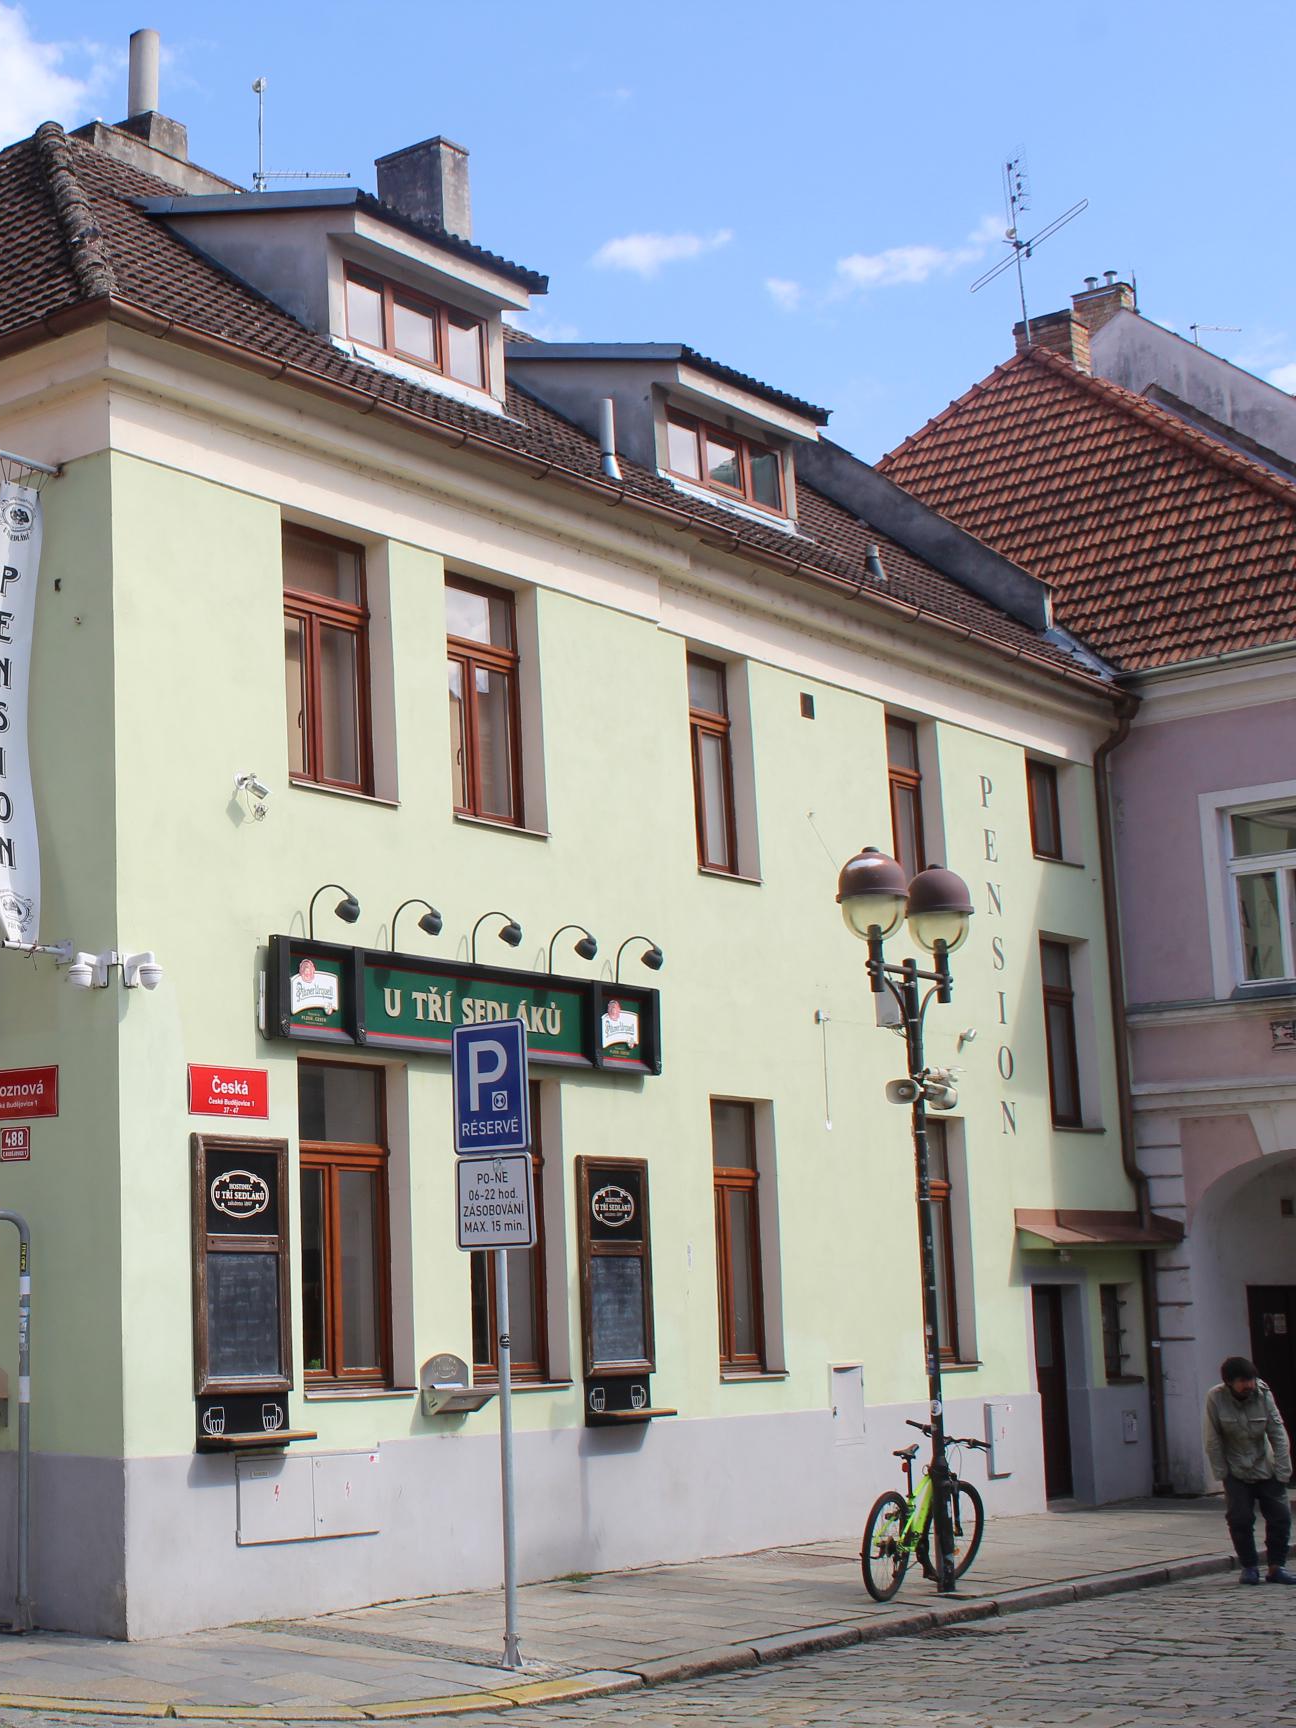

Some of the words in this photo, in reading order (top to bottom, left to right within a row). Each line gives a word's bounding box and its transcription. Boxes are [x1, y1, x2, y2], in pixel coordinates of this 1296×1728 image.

[978, 774, 1016, 1136] PENSION
[384, 987, 401, 1017] U
[412, 986, 452, 1023] TŘÍ
[468, 1040, 507, 1111] P
[211, 1075, 249, 1095] Česká
[462, 1116, 519, 1137] RÉSERVÉ
[5, 1131, 24, 1147] 488
[477, 1171, 508, 1184] PO-NE
[215, 1190, 220, 1199] U
[221, 1189, 233, 1199] TŘÍ
[234, 1190, 265, 1200] SEDLÁKŮ
[468, 1188, 496, 1201] 06-22
[498, 1187, 518, 1199] hod.
[463, 1200, 524, 1217] ZÁSOBOVÁNÍ
[464, 1221, 489, 1233] MAX.
[491, 1220, 501, 1232] 15
[504, 1219, 525, 1231] min.
